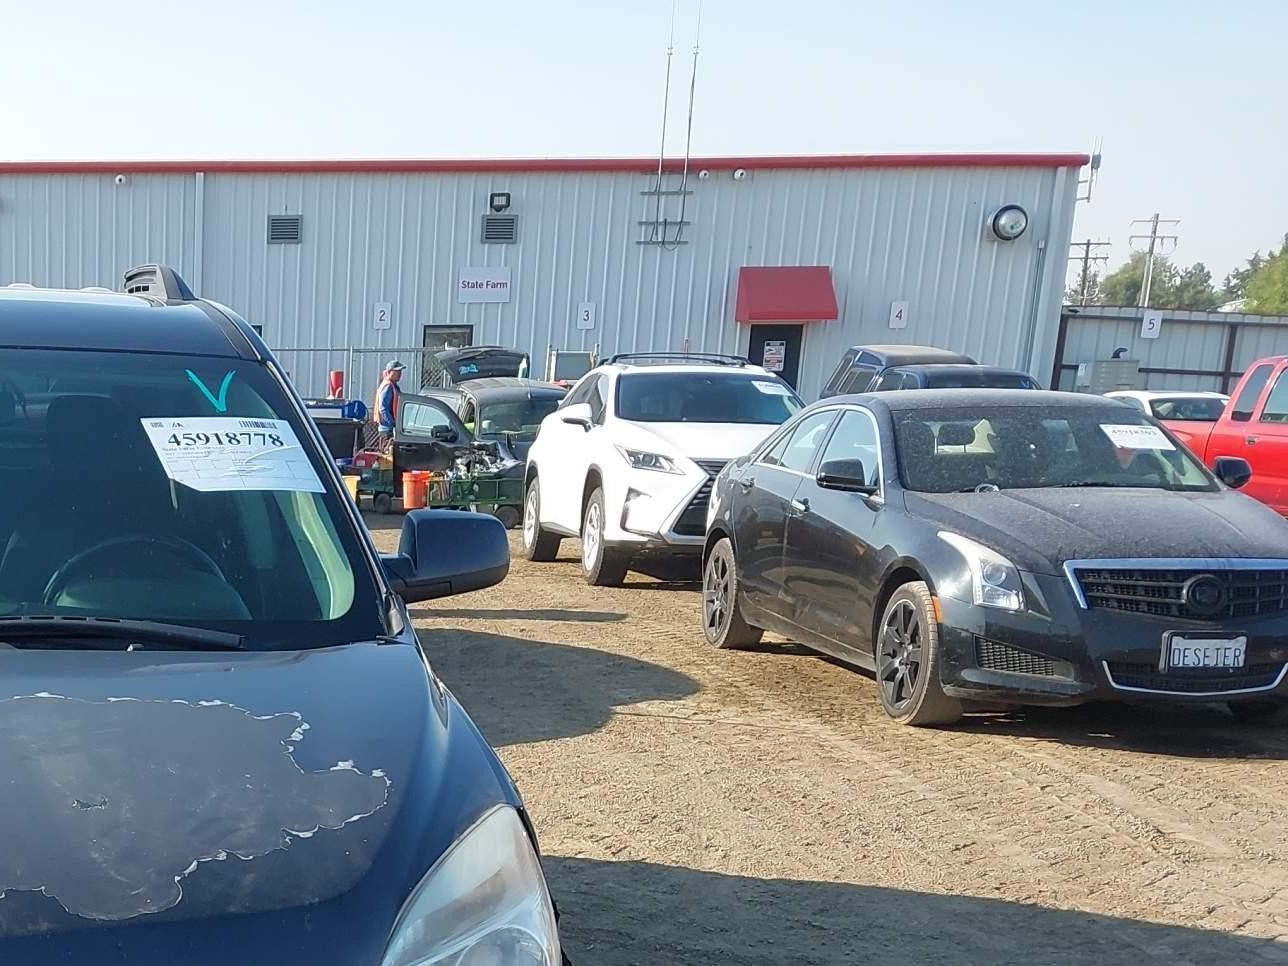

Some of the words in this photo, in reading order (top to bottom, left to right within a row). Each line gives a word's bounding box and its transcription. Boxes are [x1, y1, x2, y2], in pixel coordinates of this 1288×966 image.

[461, 279, 484, 289] State
[485, 280, 508, 289] Farm
[379, 309, 386, 321] 2
[583, 310, 590, 321] 3
[895, 308, 903, 321] 4
[1147, 318, 1156, 330] 5
[168, 432, 284, 447] 45918778
